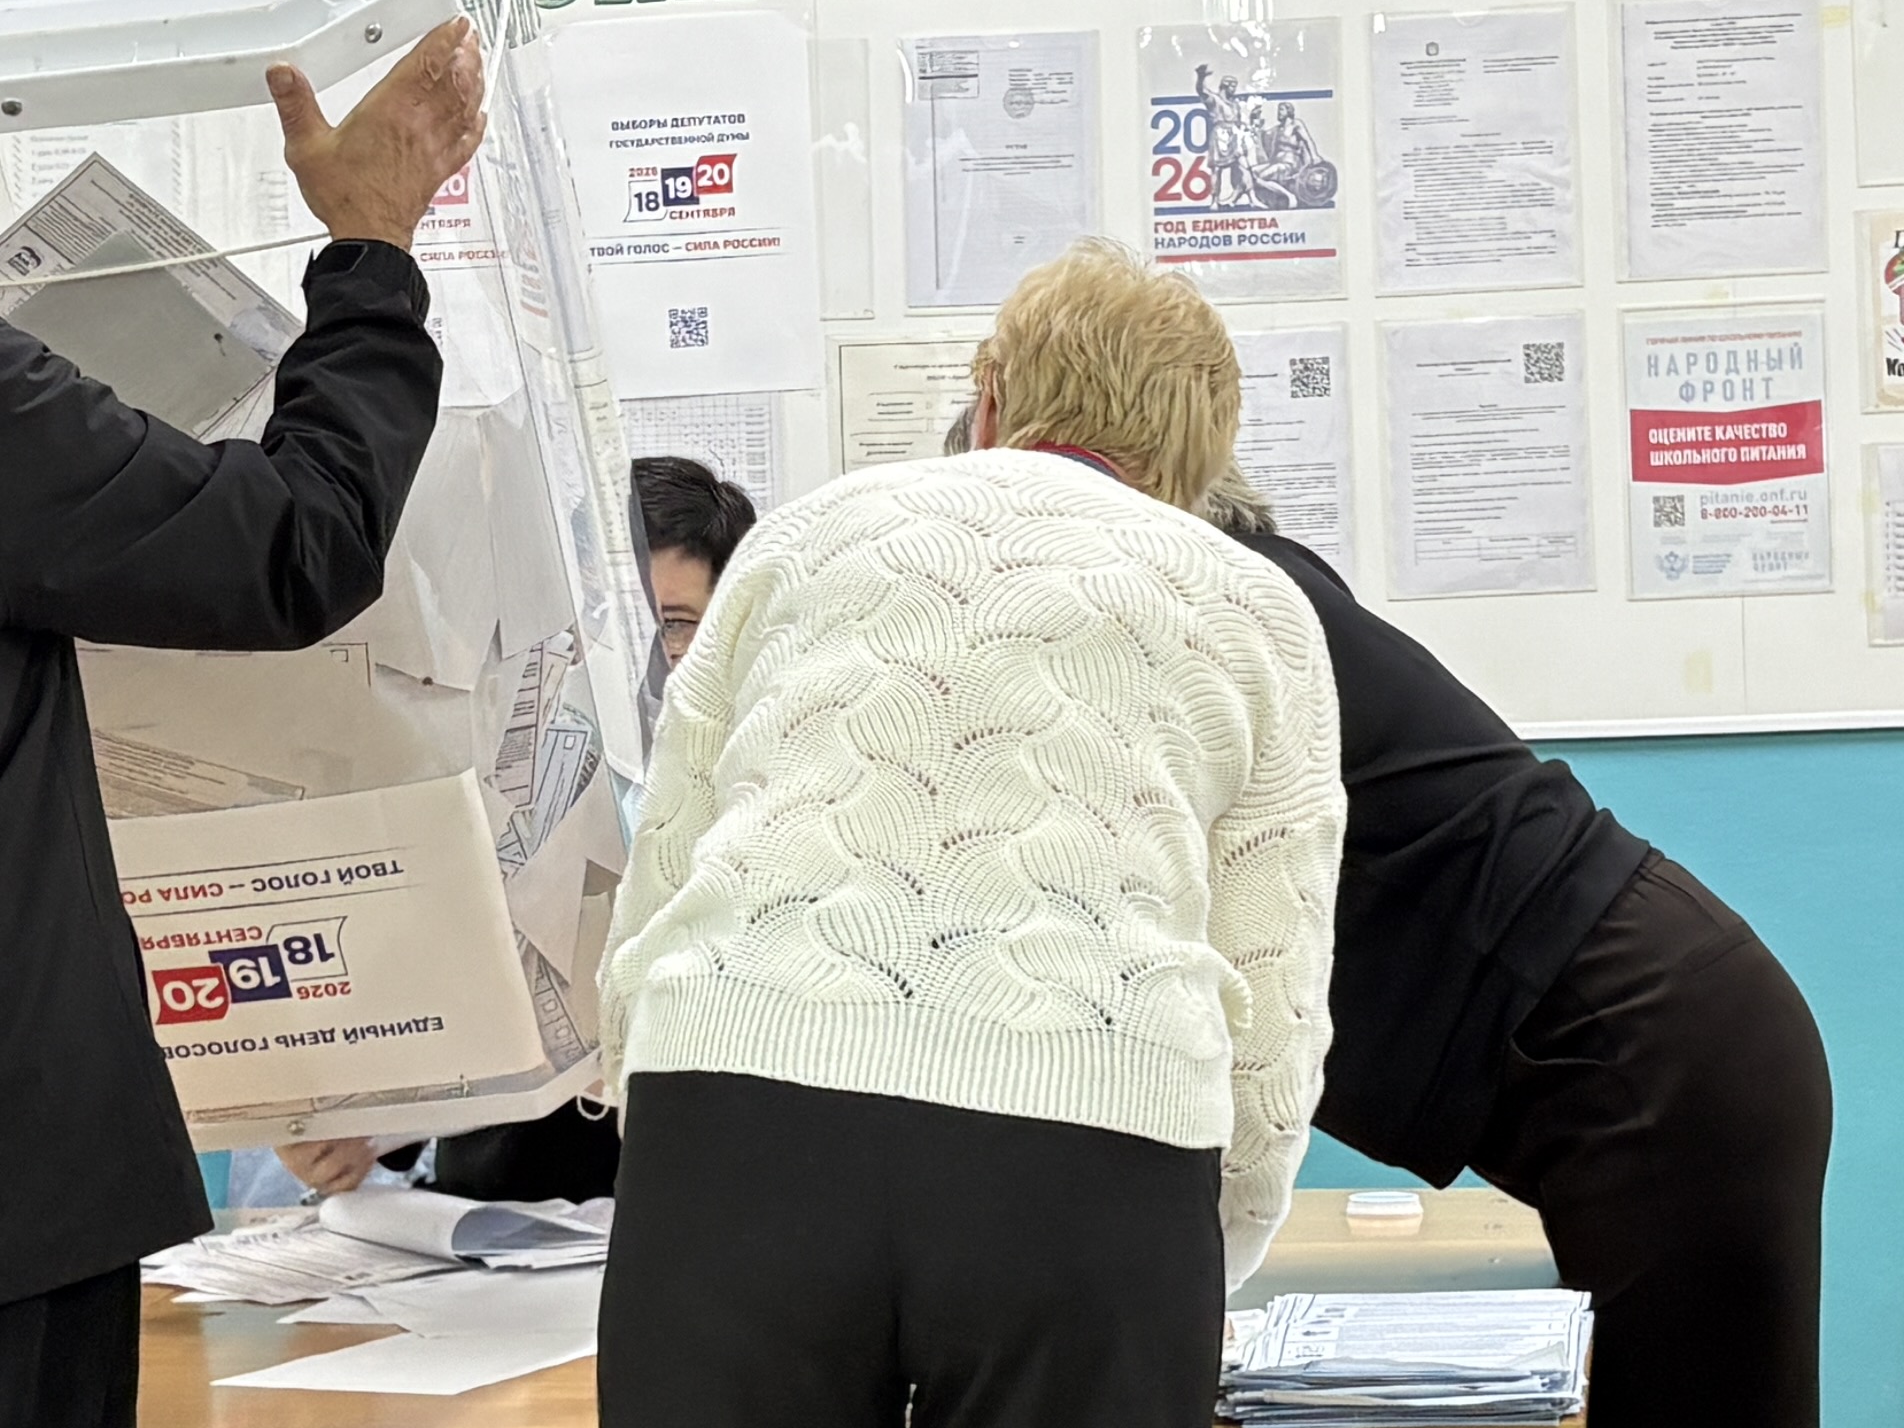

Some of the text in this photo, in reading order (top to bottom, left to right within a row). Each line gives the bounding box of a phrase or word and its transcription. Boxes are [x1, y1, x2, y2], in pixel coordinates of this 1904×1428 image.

[610, 113, 746, 133] ВЫБОРЫ ДЕПУТАТОВ
[1151, 109, 1212, 156] 20
[633, 162, 730, 214] 18 19 20
[1152, 157, 1212, 203] 26
[1154, 217, 1279, 234] ГОД ЕДИНСТВА
[589, 243, 624, 258] ТВОЙ
[626, 241, 670, 256] ГОЛОС
[684, 240, 720, 253] СИЛА
[1154, 231, 1306, 249] НАРОДОВ РОССИИ
[1646, 342, 1803, 378] НАРОДНЫЙ
[1678, 376, 1774, 402] ФРОНТ
[1649, 421, 1788, 446] ОЦЕНИТЕ КАЧЕСТВО
[1649, 443, 1807, 468] ШКОЛЬНОГО ПИТАНИЯ
[1700, 488, 1808, 507] pitanie.onf.ru
[251, 867, 331, 892] ГОЛОС
[337, 859, 404, 885] ТВОЙ
[156, 881, 225, 901] СИЛА
[141, 925, 263, 952] СЕНТЯБРЯ
[161, 932, 336, 1012] 18 19 20
[296, 980, 352, 1000] 2026
[274, 1027, 335, 1048] ДЕНЬ
[342, 1014, 445, 1042] ЕДИНЫЙ
